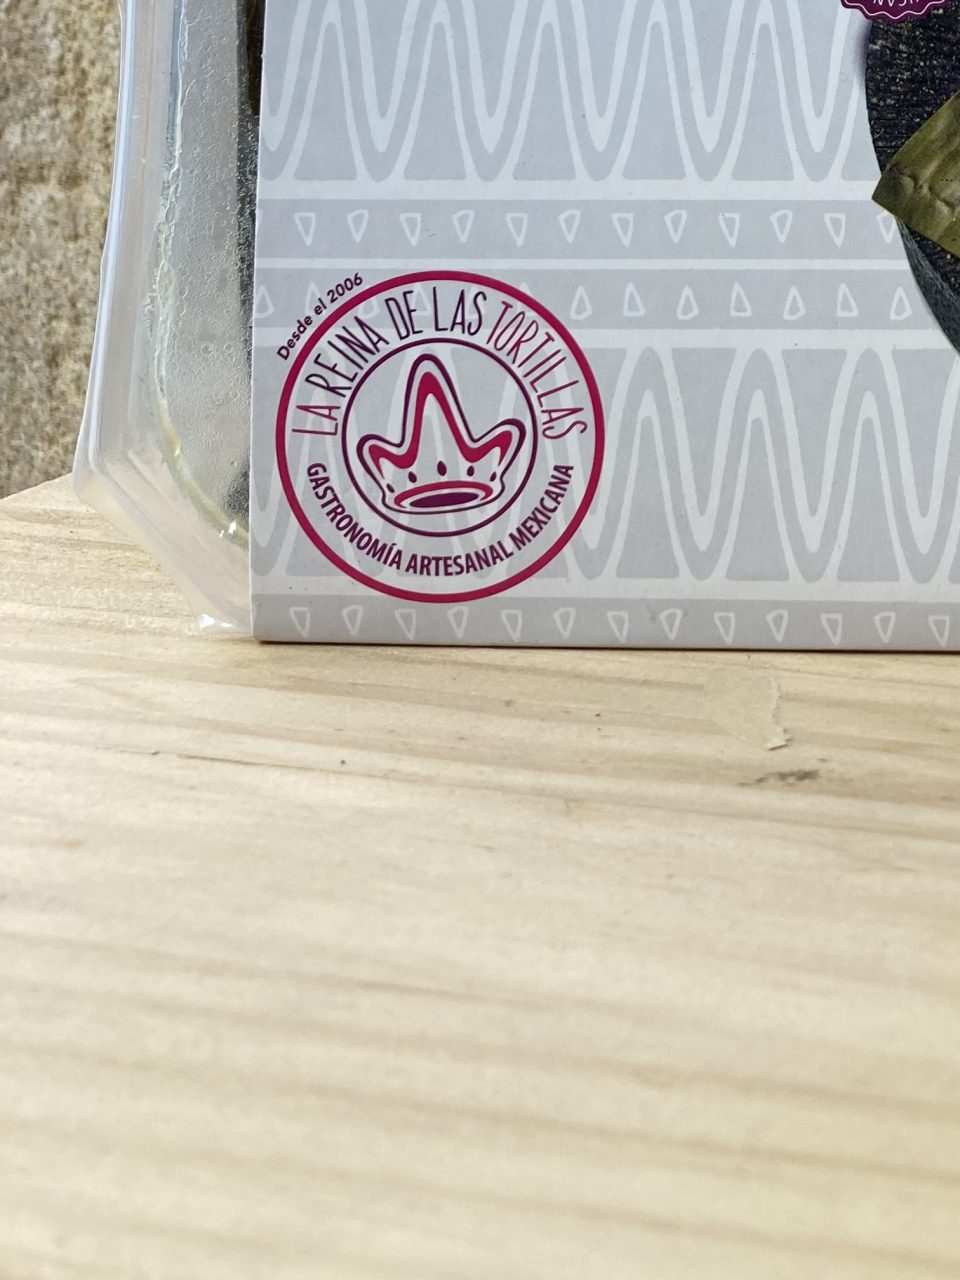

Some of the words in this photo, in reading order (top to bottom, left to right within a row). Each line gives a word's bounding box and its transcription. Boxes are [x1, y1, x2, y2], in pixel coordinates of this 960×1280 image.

[276, 315, 313, 361] Desde
[313, 298, 328, 317] el
[326, 272, 364, 304] 2006
[384, 290, 424, 340] DE
[432, 286, 487, 336] LAS
[305, 315, 390, 398] REINA
[486, 300, 588, 440] TORTILLAS
[291, 404, 341, 436] LA
[306, 463, 402, 570] GASTRONOMÍA
[405, 540, 514, 577] ARTESANAL
[508, 464, 575, 552] MEXICANA
